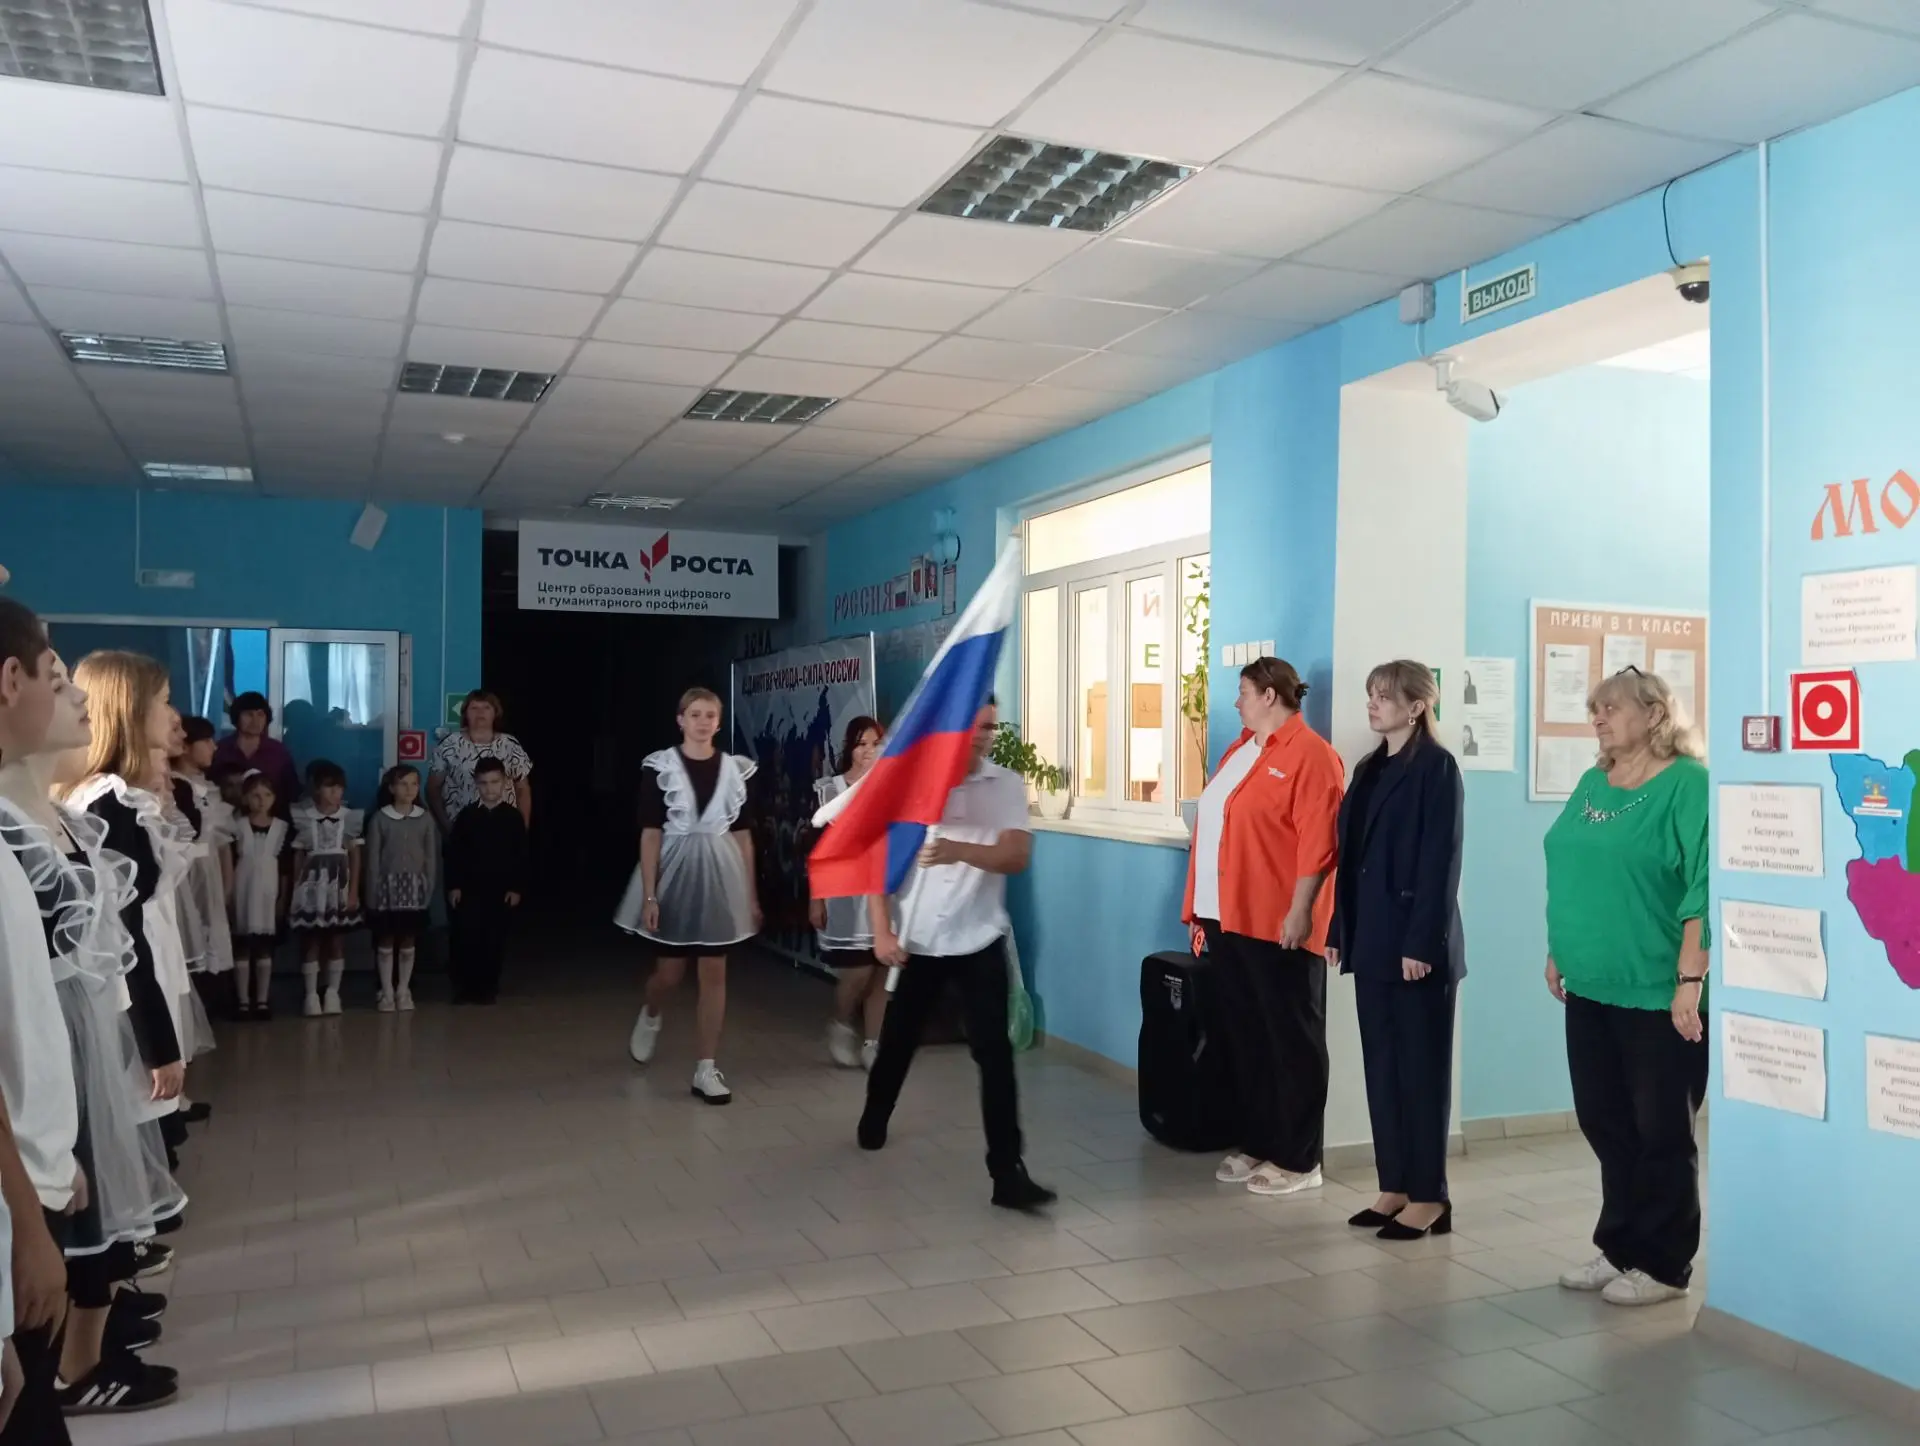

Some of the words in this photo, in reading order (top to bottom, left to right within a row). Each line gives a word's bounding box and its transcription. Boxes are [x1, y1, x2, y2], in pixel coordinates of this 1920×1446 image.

[1473, 274, 1529, 312] ВЫХОД
[537, 548, 631, 571] ТОЧКА
[671, 555, 755, 576] РОСТА
[537, 580, 577, 595] Центр
[579, 582, 661, 598] образования
[664, 588, 732, 600] цифрового
[833, 578, 893, 625] РОССИЯ
[549, 597, 642, 609] гуманитарного
[645, 599, 709, 611] профилей
[1550, 611, 1603, 630] ПРИЕМ
[1610, 615, 1620, 631] В
[1626, 617, 1633, 631] 1
[1641, 618, 1692, 637] КЛАСС
[1144, 643, 1161, 668] Е
[825, 657, 860, 685] РОССИИ
